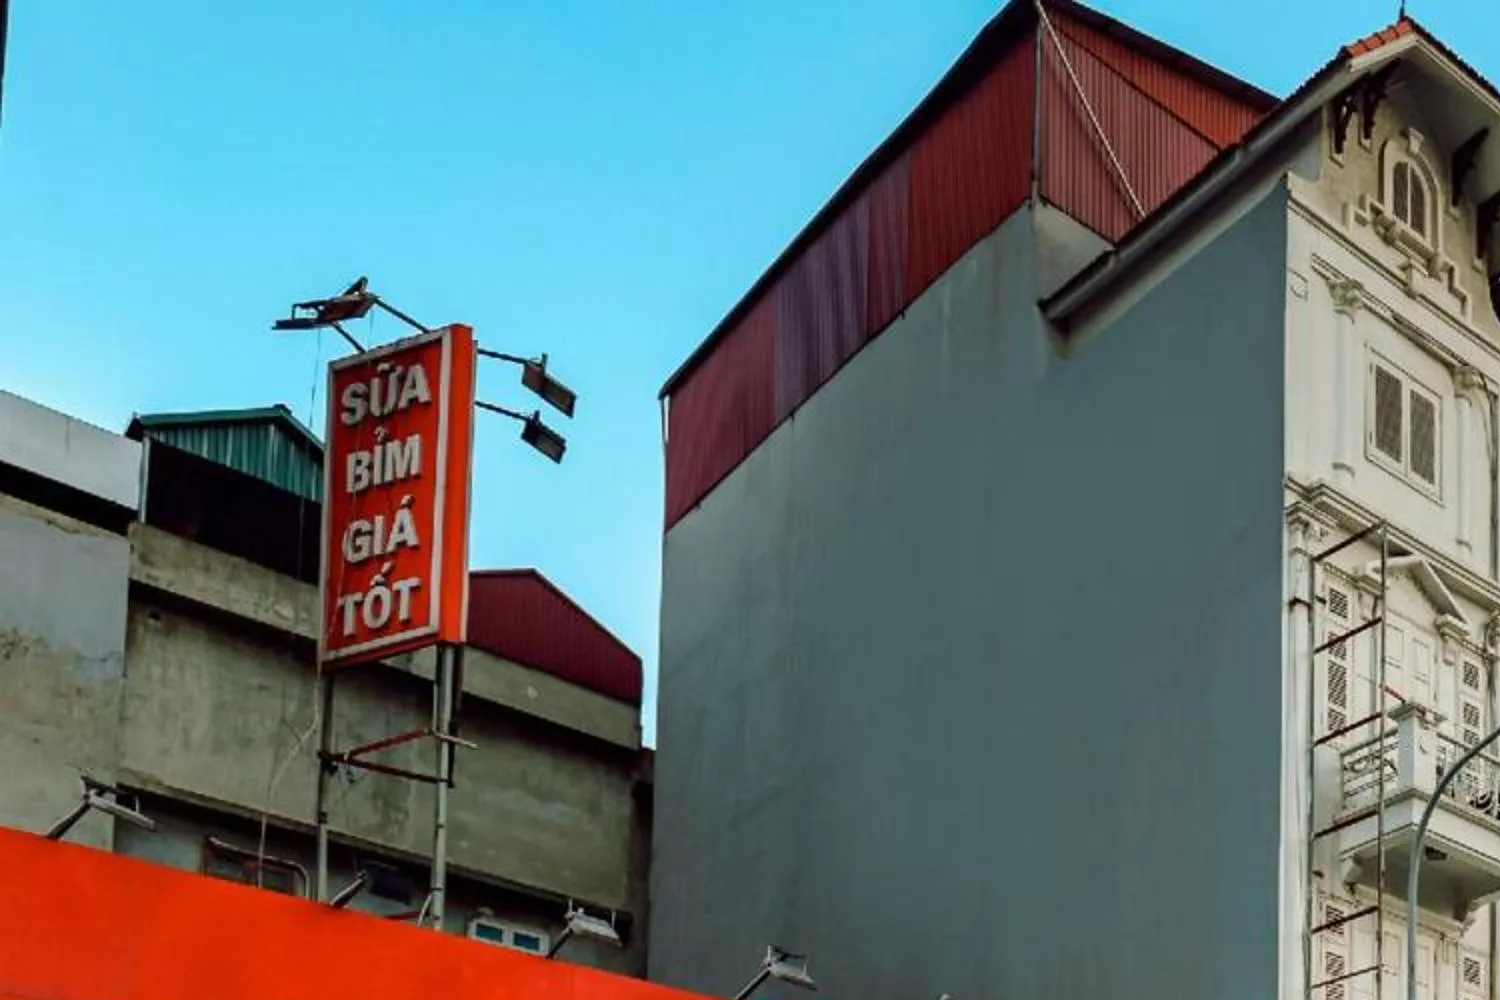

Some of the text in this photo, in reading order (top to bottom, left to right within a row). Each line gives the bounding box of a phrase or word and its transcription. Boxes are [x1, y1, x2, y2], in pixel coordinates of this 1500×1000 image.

[341, 363, 432, 426] SỮA
[345, 426, 422, 493] BỈM
[343, 494, 420, 564] GIÁ
[337, 561, 421, 637] TỐT
